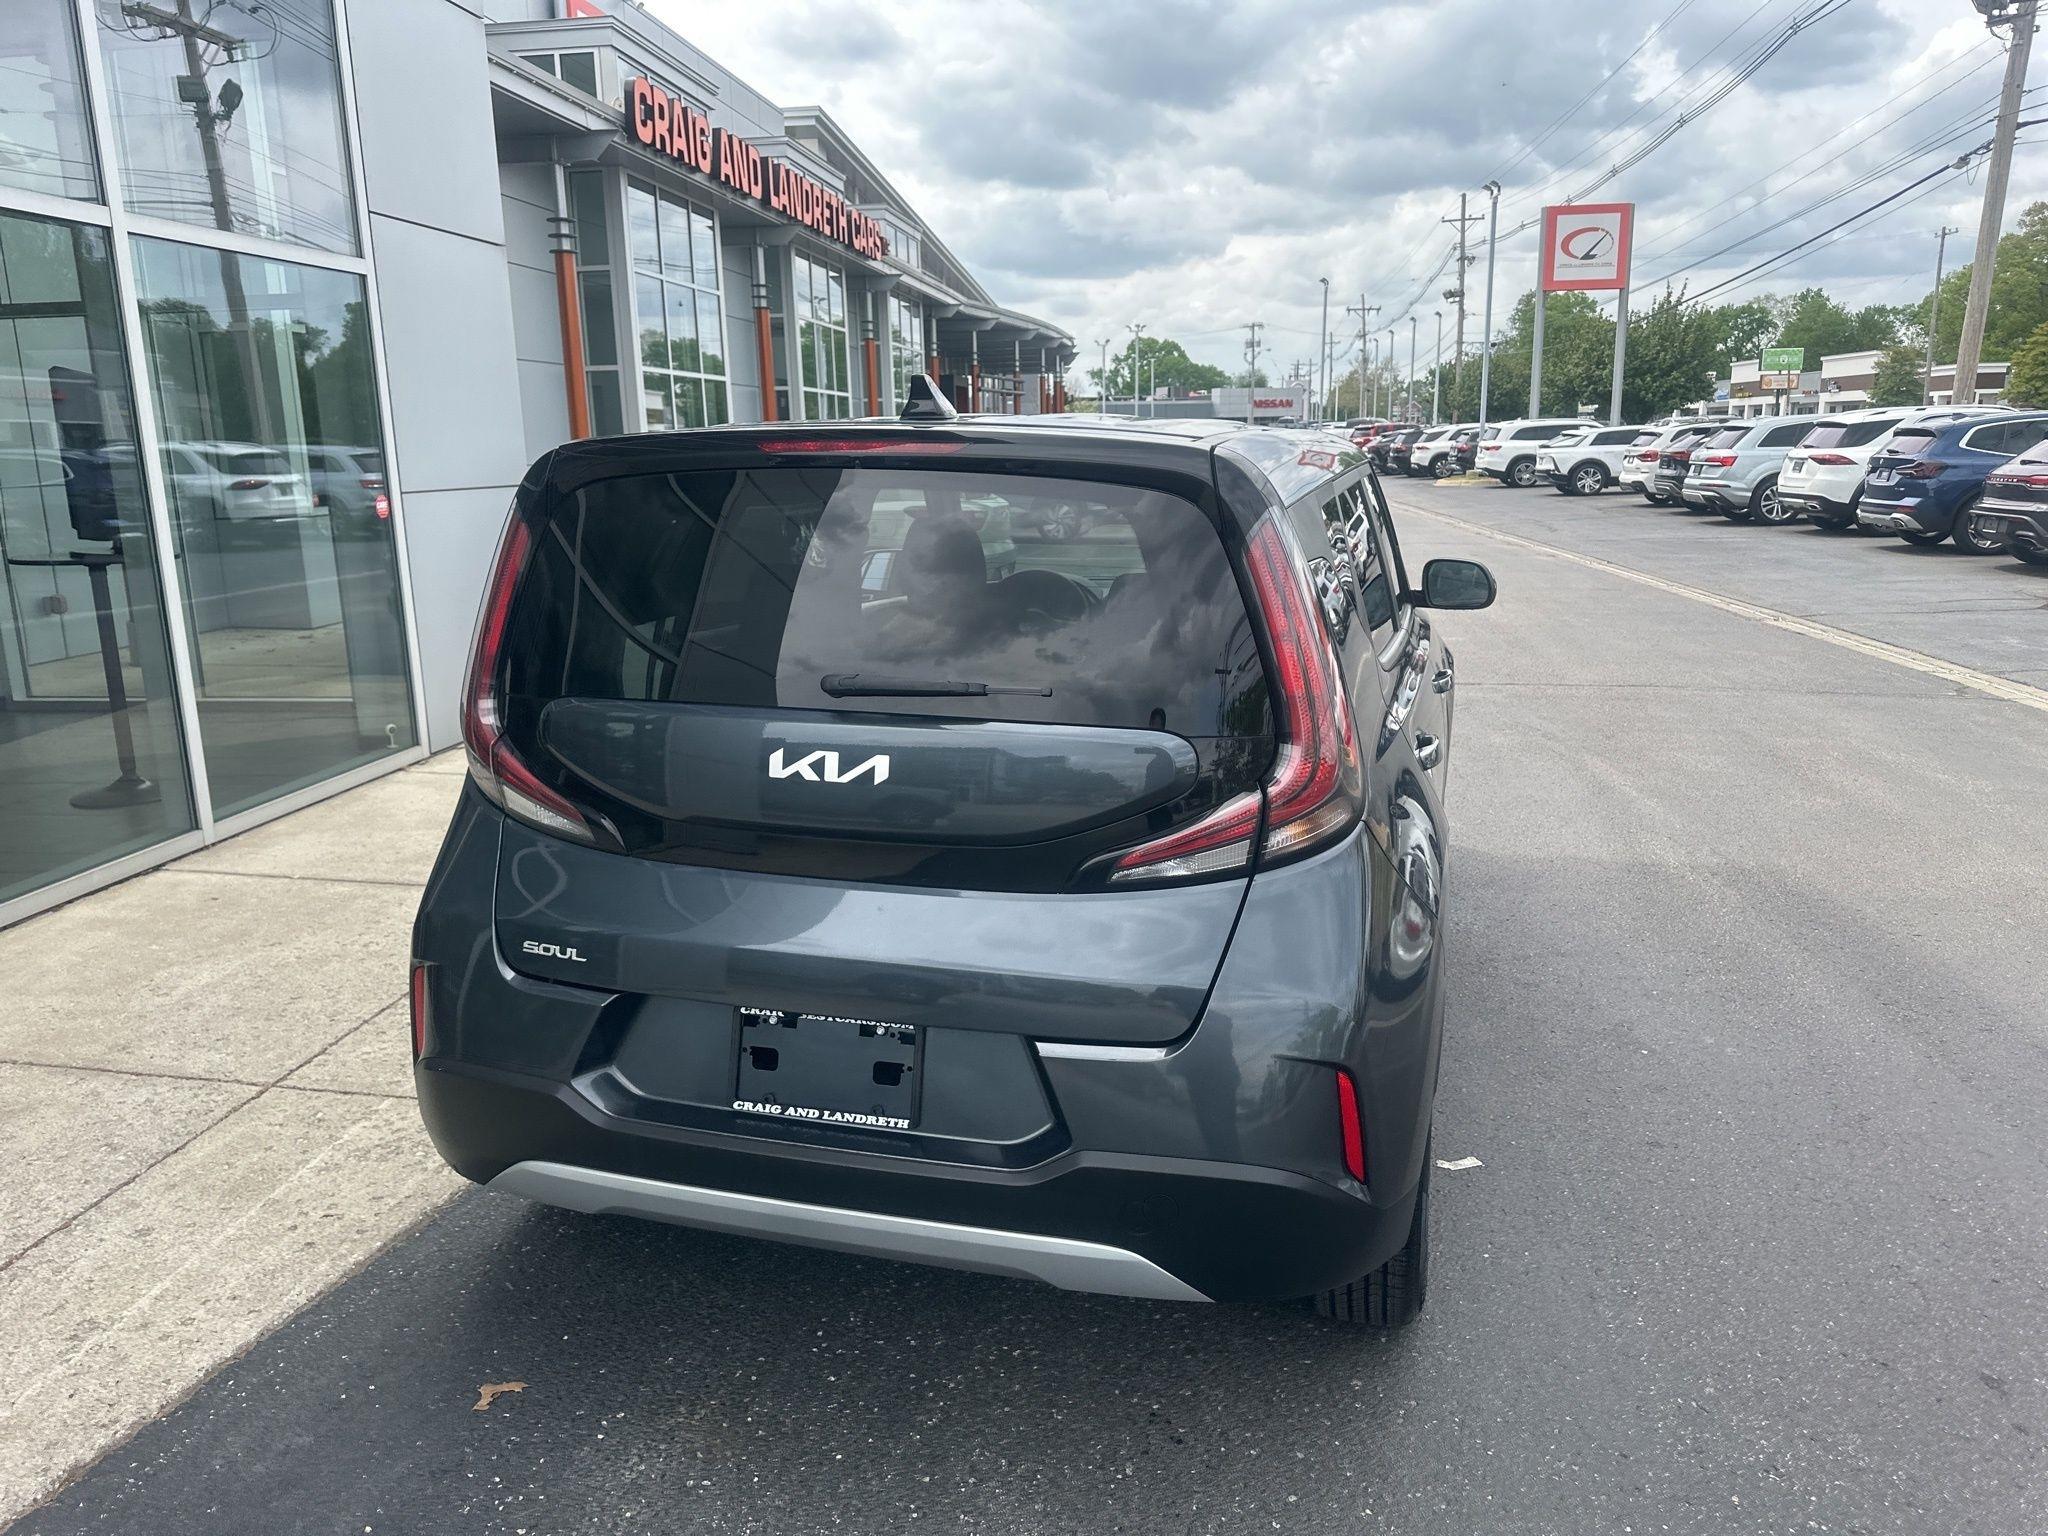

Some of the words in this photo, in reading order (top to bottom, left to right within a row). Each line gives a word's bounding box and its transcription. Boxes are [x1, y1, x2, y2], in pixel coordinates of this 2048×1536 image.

[633, 75, 712, 174] CRAIG
[720, 127, 763, 200] AND
[768, 156, 849, 245] LANDRETH
[852, 208, 882, 261] CARS
[1253, 399, 1294, 409] NISSAN
[768, 747, 890, 786] KIA
[522, 940, 588, 962] SOUL
[732, 1100, 782, 1114] CRAIG
[784, 1106, 819, 1118] AND
[822, 1110, 910, 1128] LANDRETH
